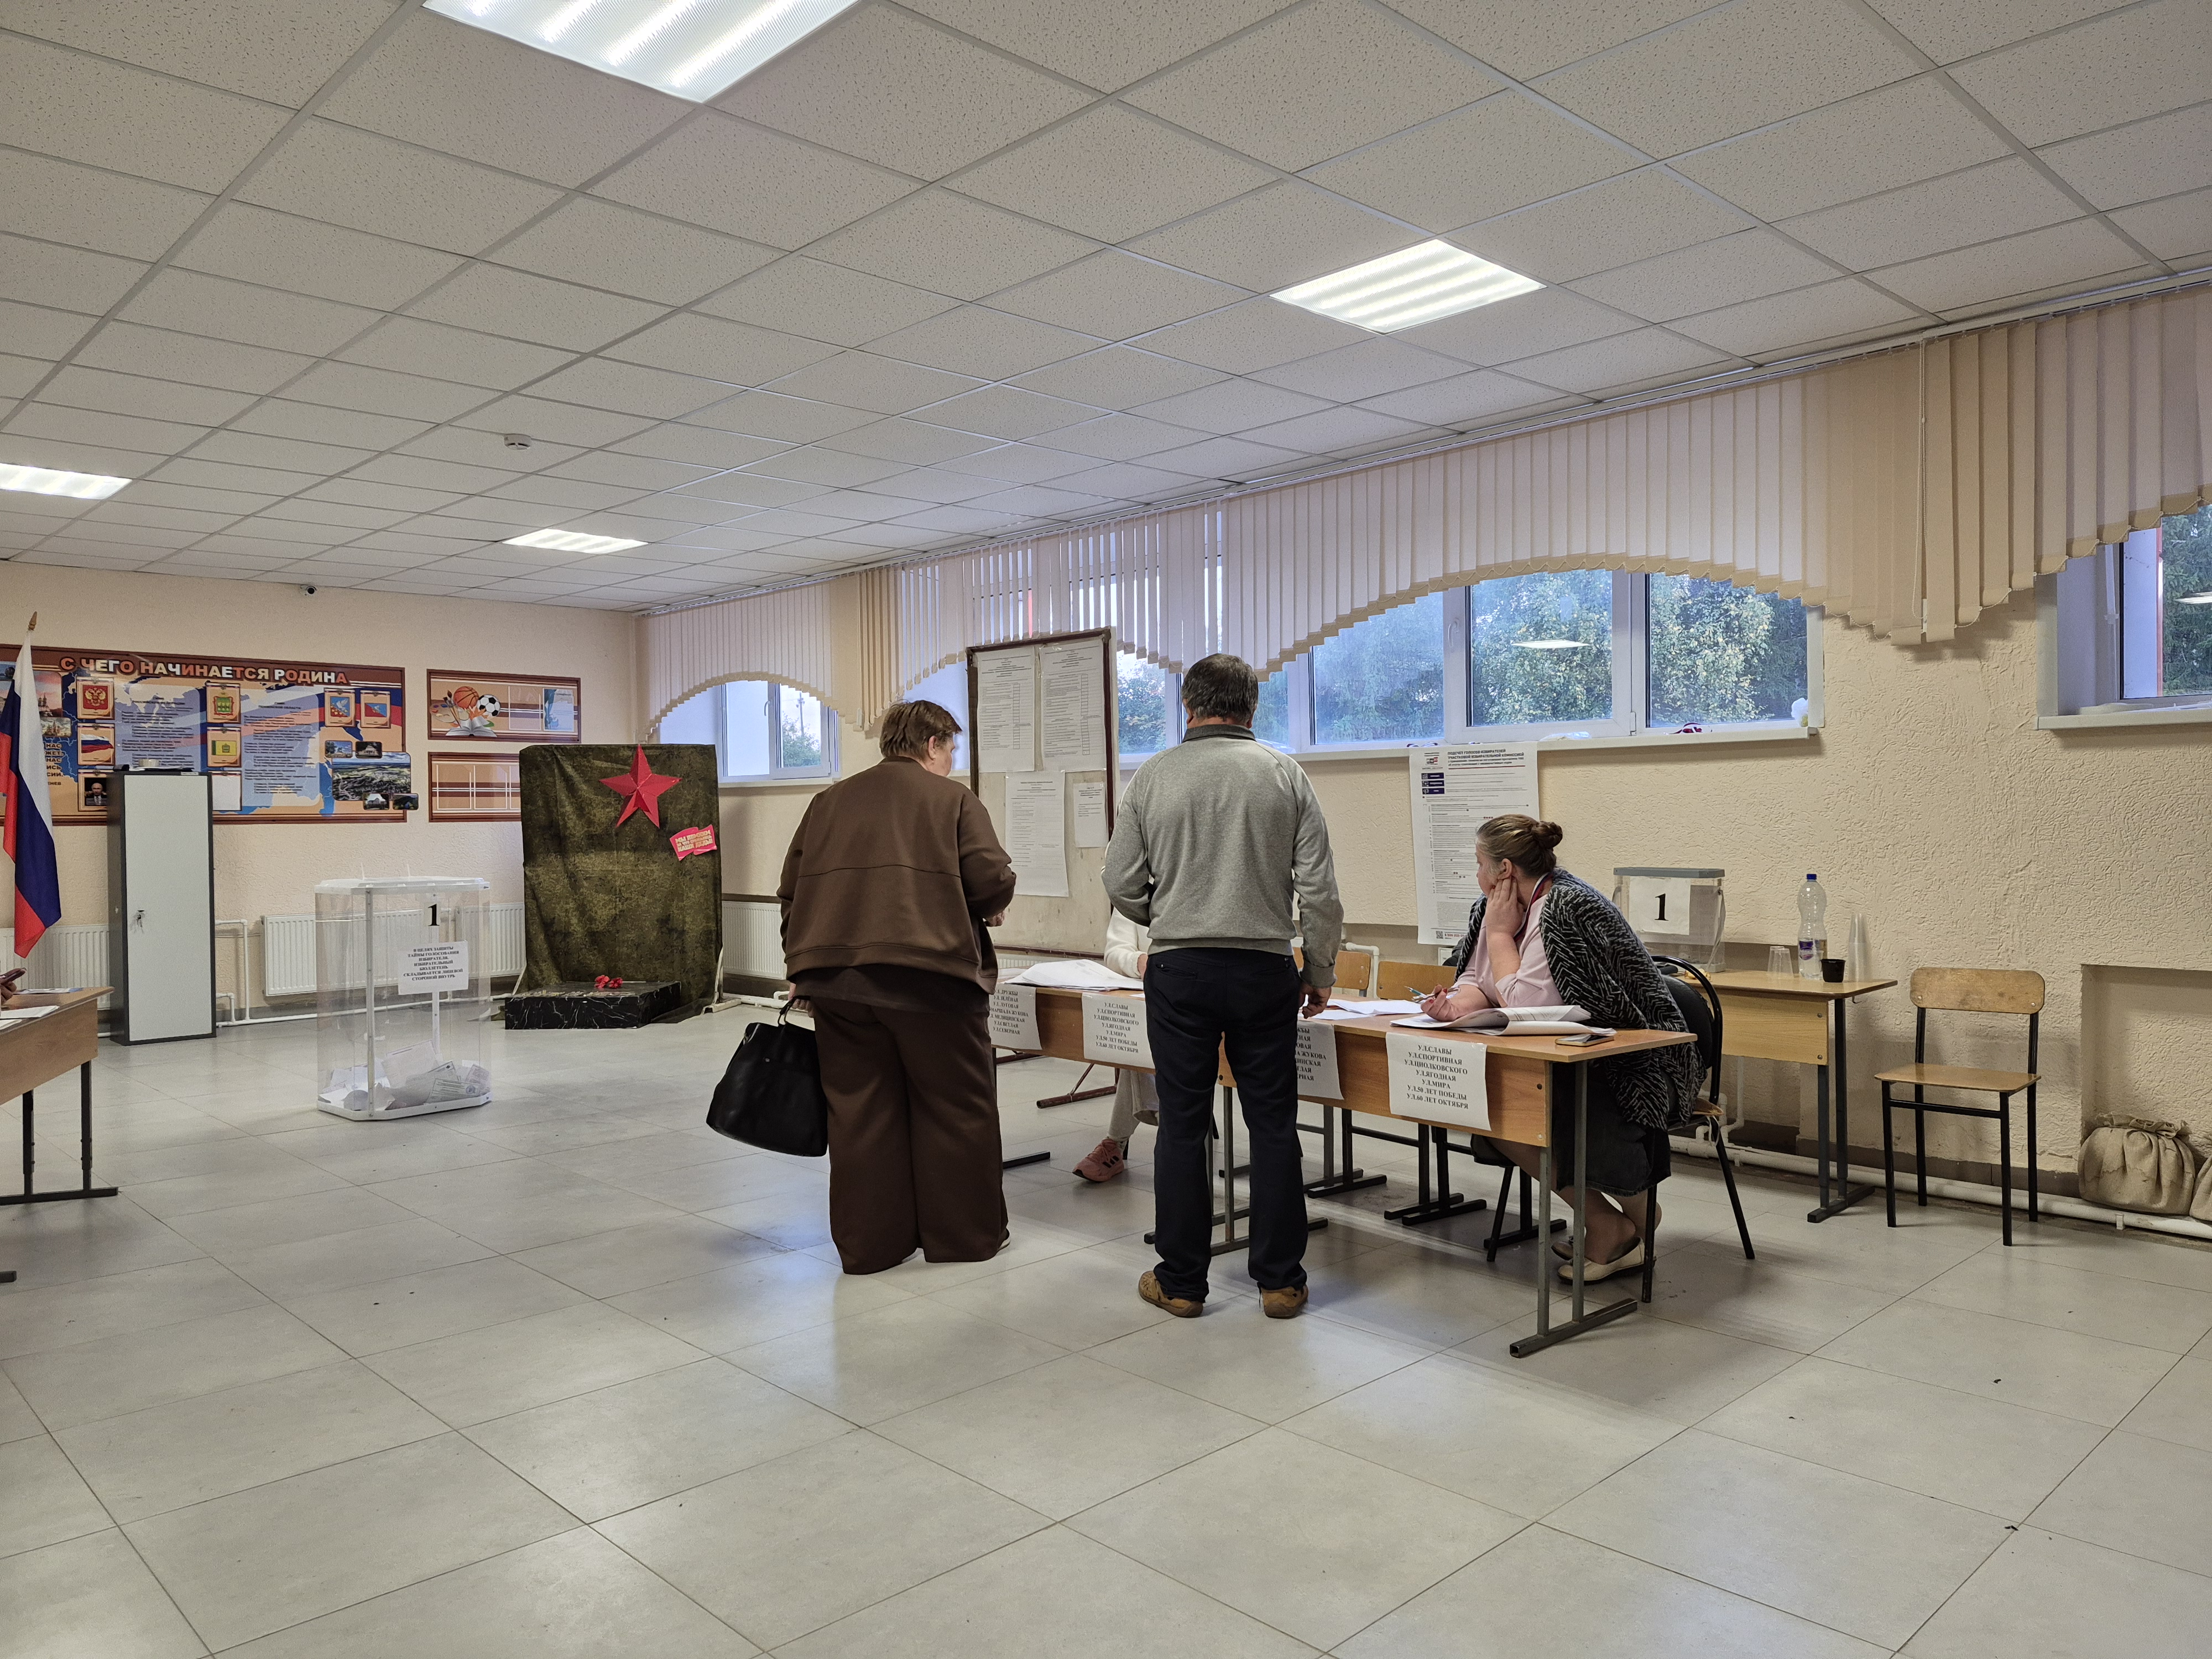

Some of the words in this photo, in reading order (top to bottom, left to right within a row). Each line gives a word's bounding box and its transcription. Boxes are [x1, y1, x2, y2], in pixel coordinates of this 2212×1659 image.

[61, 658, 75, 670] С
[81, 659, 134, 673] ЧЕГО
[140, 662, 269, 680] НАЧИНАЕТСЯ
[274, 669, 348, 684] РОДИНА
[1654, 893, 1670, 921] 1
[427, 904, 440, 927] 1
[1117, 1045, 1139, 1053] ОКТЯБРЯ
[1301, 1051, 1327, 1060] ЖУКОВА
[1418, 1045, 1452, 1055] УЛ.СЛАВЫ
[1408, 1051, 1462, 1065] УЛ.СПОРТИВНАЯ
[1405, 1059, 1468, 1075] УЛ.ЦИОЛКОВСКОГО
[1416, 1069, 1456, 1082] УЛ.ЯГОДНАЯ
[1422, 1079, 1451, 1089] УЛ.МИРА
[1407, 1084, 1423, 1093] УЛ.50
[1438, 1090, 1467, 1100] ПОБЕДЫ
[1407, 1093, 1423, 1101] УЛ.60
[1438, 1098, 1469, 1109] ОКТЯБРЯ
